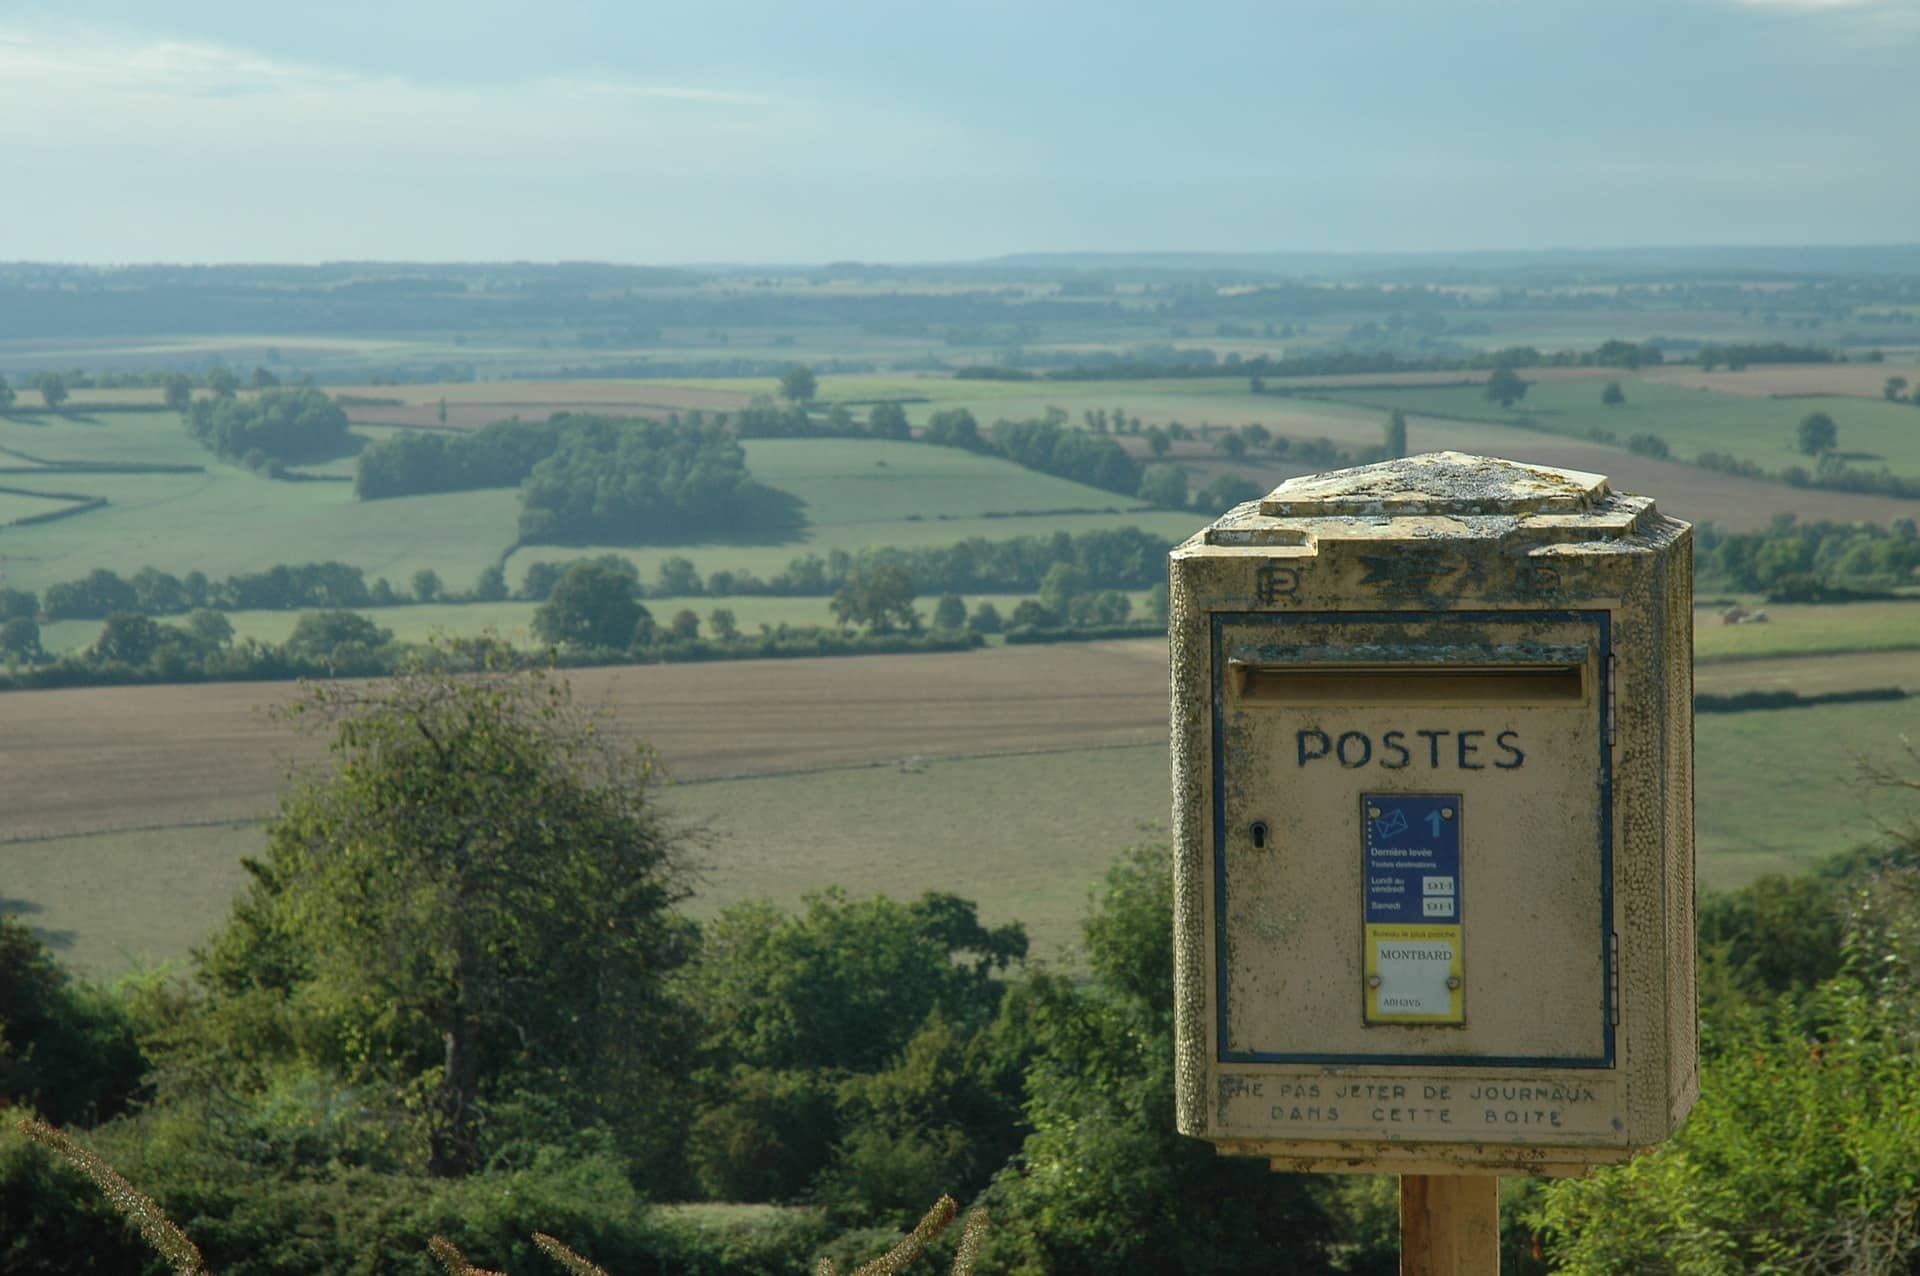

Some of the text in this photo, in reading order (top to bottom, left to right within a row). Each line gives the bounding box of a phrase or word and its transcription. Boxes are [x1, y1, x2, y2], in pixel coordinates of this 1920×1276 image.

[1296, 729, 1526, 770] POSTES
[1371, 847, 1433, 857] Dernière levée
[1380, 949, 1453, 961] MONTBARD
[1280, 1084, 1320, 1099] PAS
[1335, 1084, 1408, 1100] JETER
[1423, 1086, 1451, 1101] DE
[1469, 1086, 1595, 1104] JOURNAUX
[1371, 1107, 1451, 1124] CETTE
[1485, 1109, 1562, 1127] BOITE
